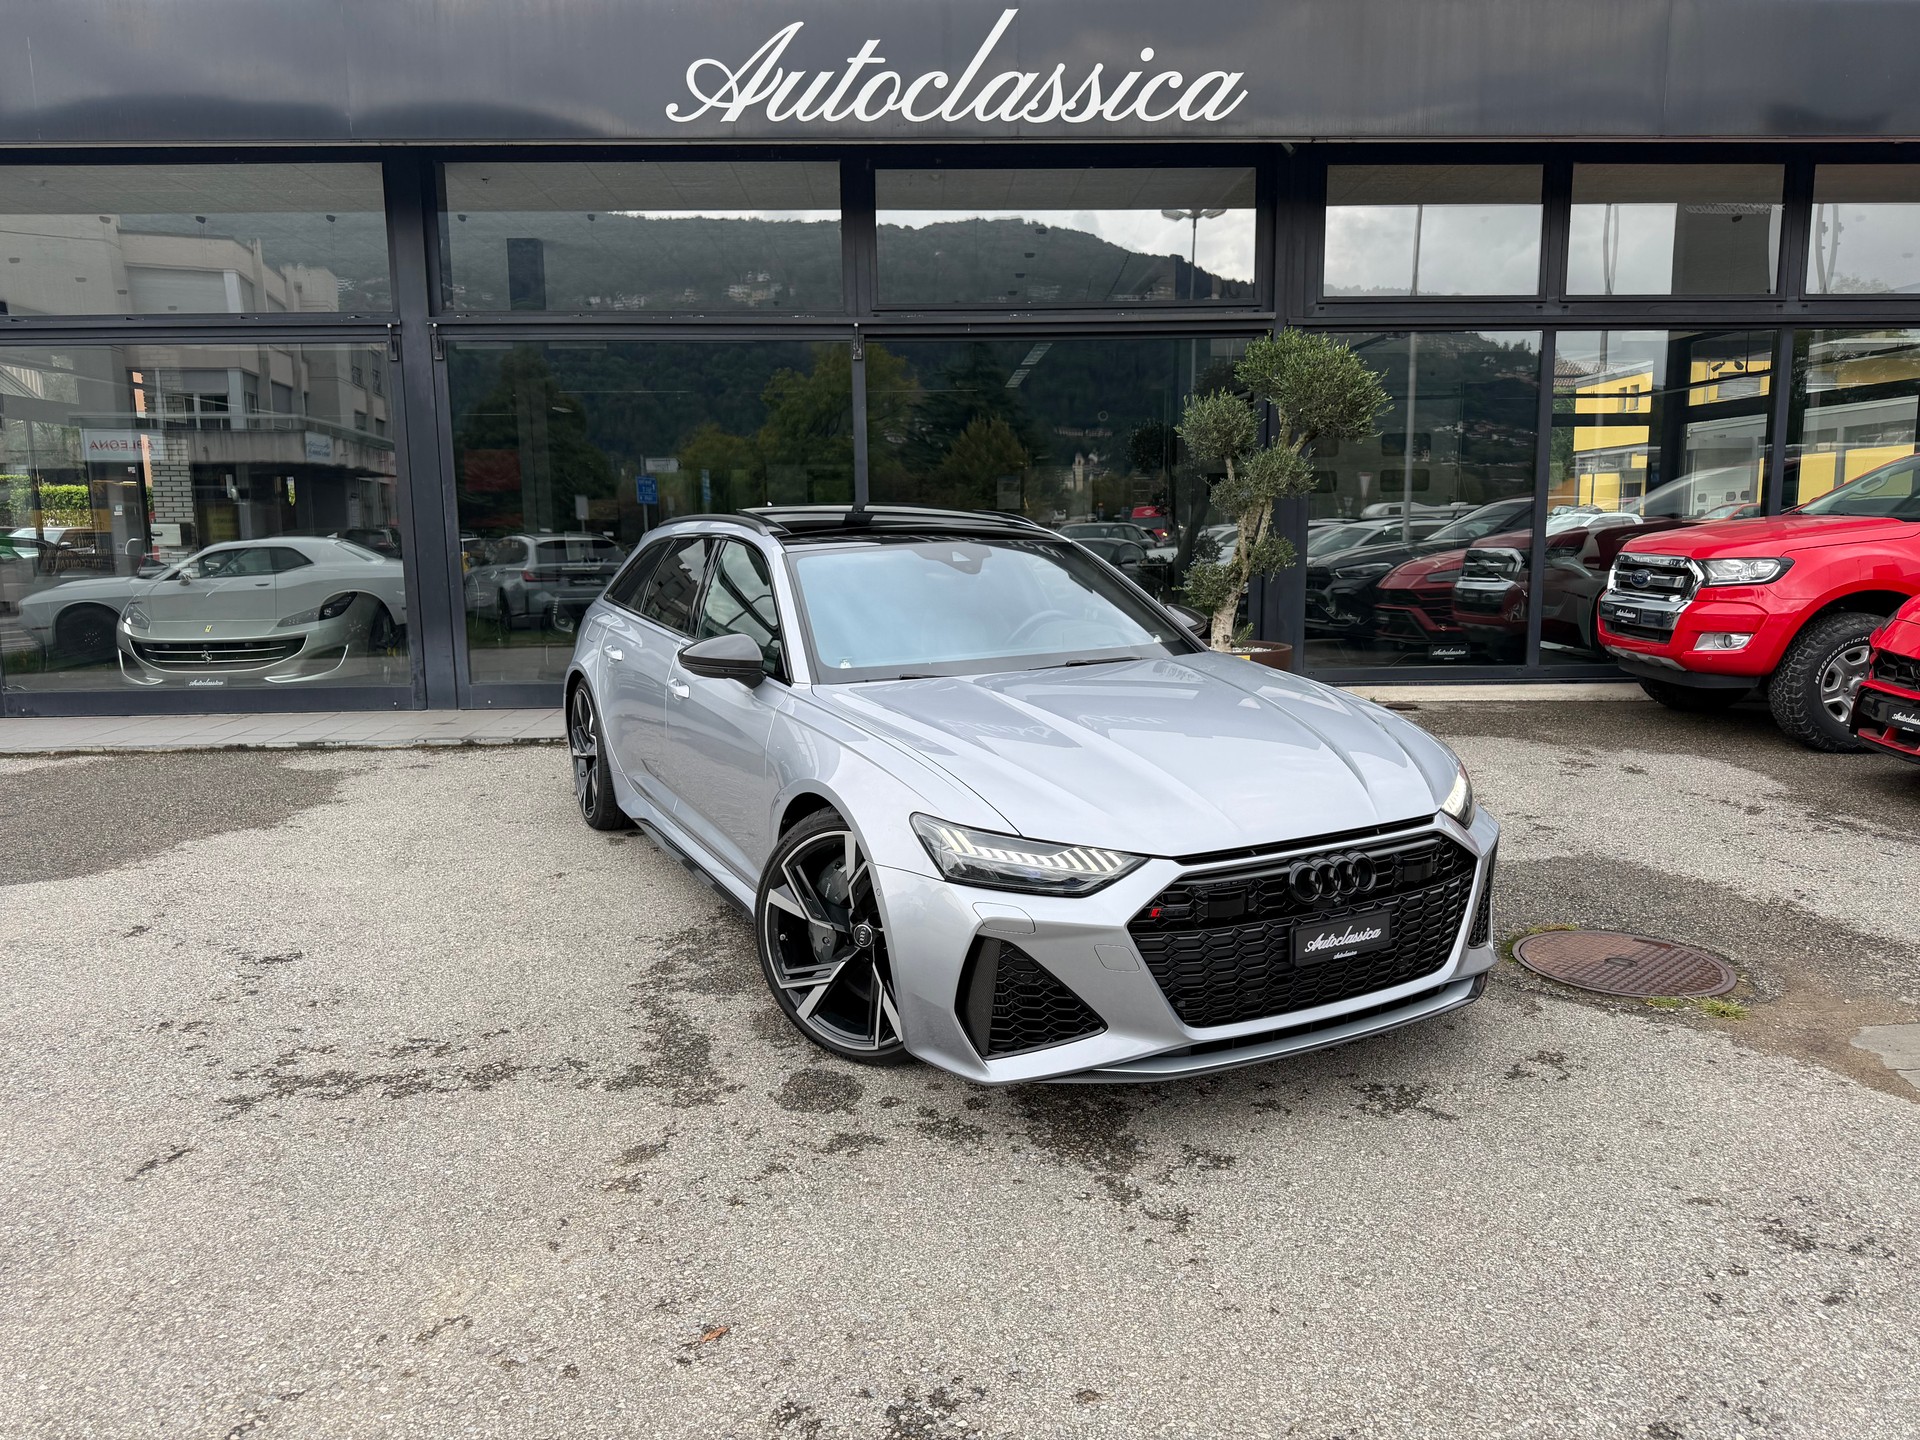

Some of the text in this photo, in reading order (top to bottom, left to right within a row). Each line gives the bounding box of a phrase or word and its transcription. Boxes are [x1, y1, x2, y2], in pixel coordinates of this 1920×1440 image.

[665, 8, 1249, 123] Autoclassica
[1814, 636, 1869, 685] BFGoodrich
[1304, 925, 1382, 953] Autoclassica
